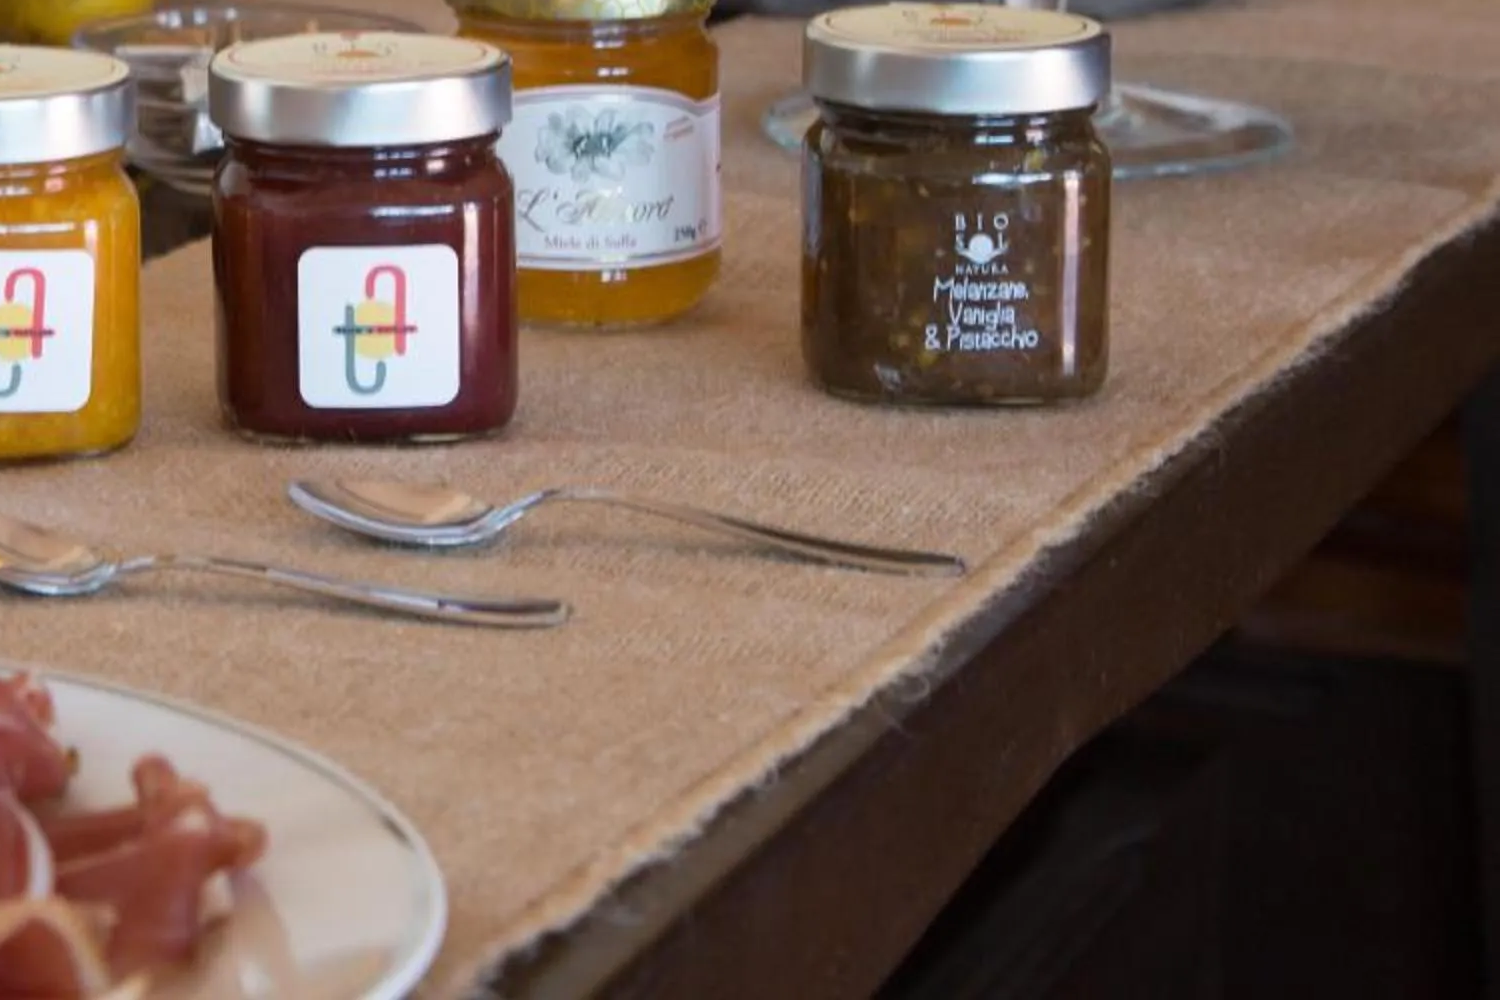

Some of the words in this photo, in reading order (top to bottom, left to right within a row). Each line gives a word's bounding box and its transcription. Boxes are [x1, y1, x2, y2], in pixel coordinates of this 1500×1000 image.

[955, 212, 1009, 230] BIO
[949, 299, 1015, 331] Vaniglia
[925, 323, 940, 350] &
[947, 322, 1039, 351] Pistacchio
